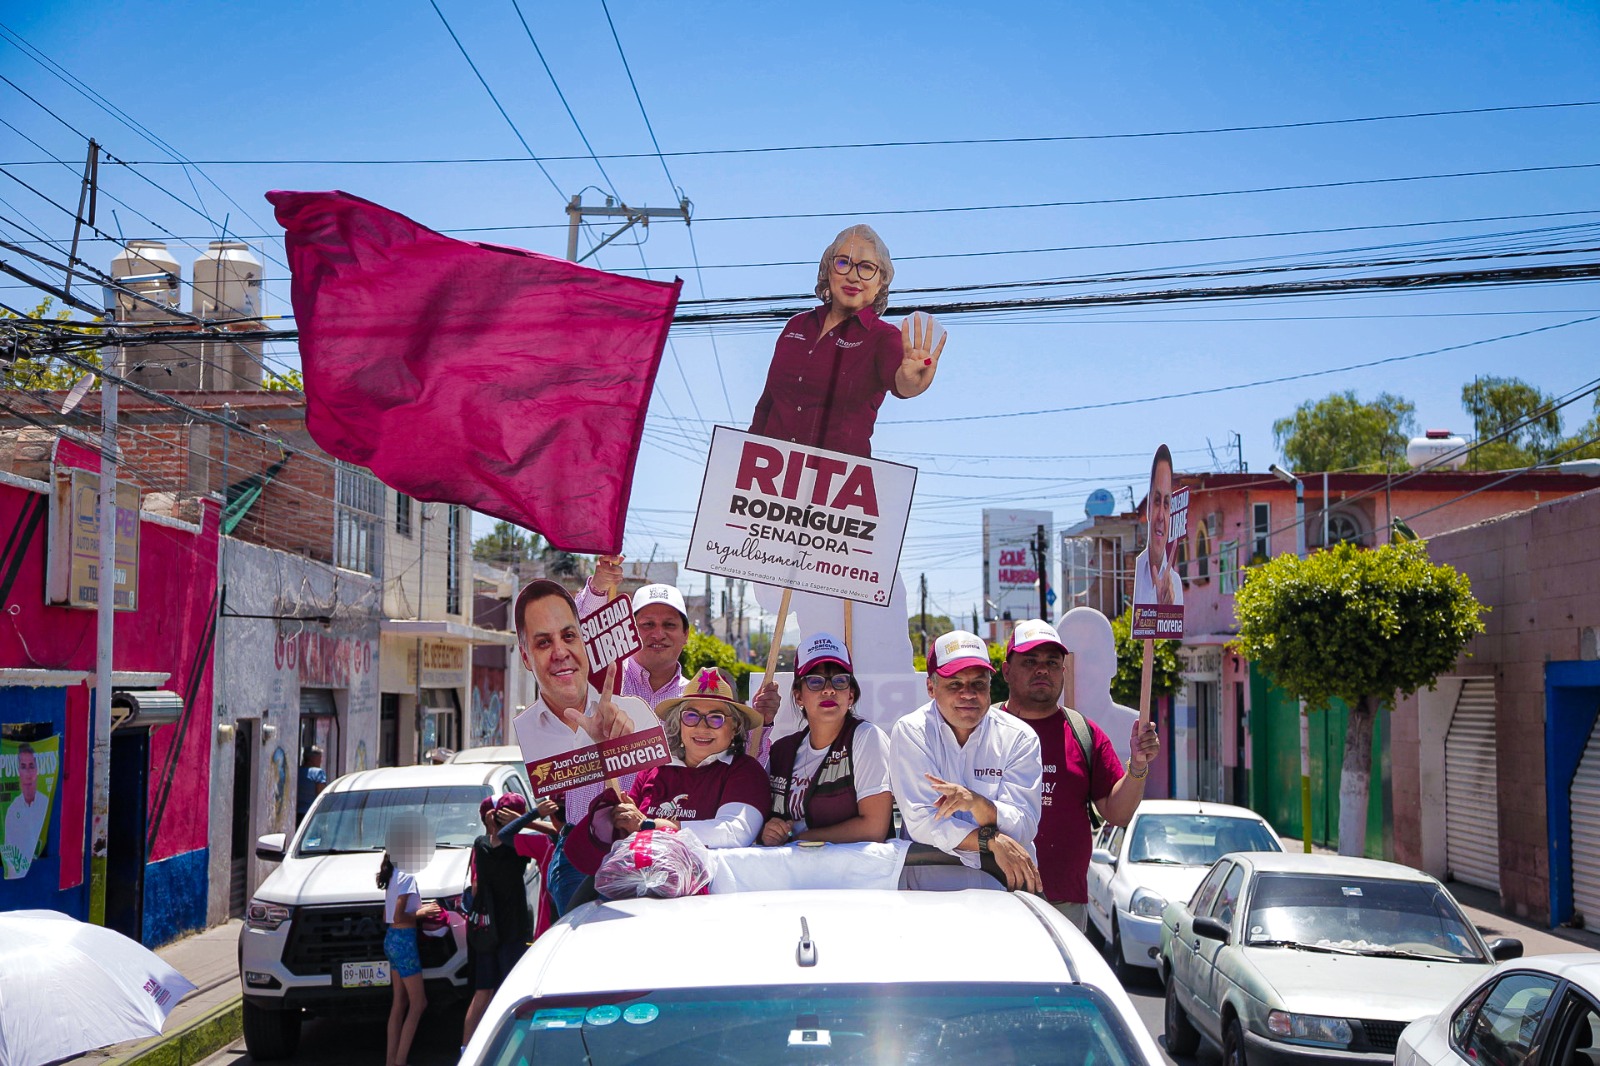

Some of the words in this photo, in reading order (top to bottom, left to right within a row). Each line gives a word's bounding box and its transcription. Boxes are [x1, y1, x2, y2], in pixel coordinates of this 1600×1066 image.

[735, 440, 879, 517] RITA
[730, 494, 877, 540] RODRÍGUEZ
[1168, 508, 1187, 543] LIBRE
[749, 523, 849, 555] SENADORA
[706, 538, 815, 571] orgullosamente
[815, 560, 879, 583] morena
[710, 563, 742, 575] Candidata
[747, 570, 775, 581] Senadora
[809, 582, 841, 594] Esperanza
[848, 589, 869, 599] México
[580, 598, 629, 643] SOLEDAD
[1157, 619, 1183, 633] morena
[585, 618, 639, 674] LIBRE
[553, 759, 573, 770] Juan
[573, 750, 599, 764] Carlos
[603, 749, 616, 757] ESTE
[629, 740, 647, 750] JUNIO
[647, 735, 662, 745] VOTA
[605, 743, 667, 772] morena
[537, 779, 572, 794] PRESIDENTE
[573, 771, 604, 785] MUNICIPAL
[550, 760, 602, 781] VELÁZQUEZ
[143, 978, 157, 994] RITA
[343, 969, 374, 980] 89-NUA
